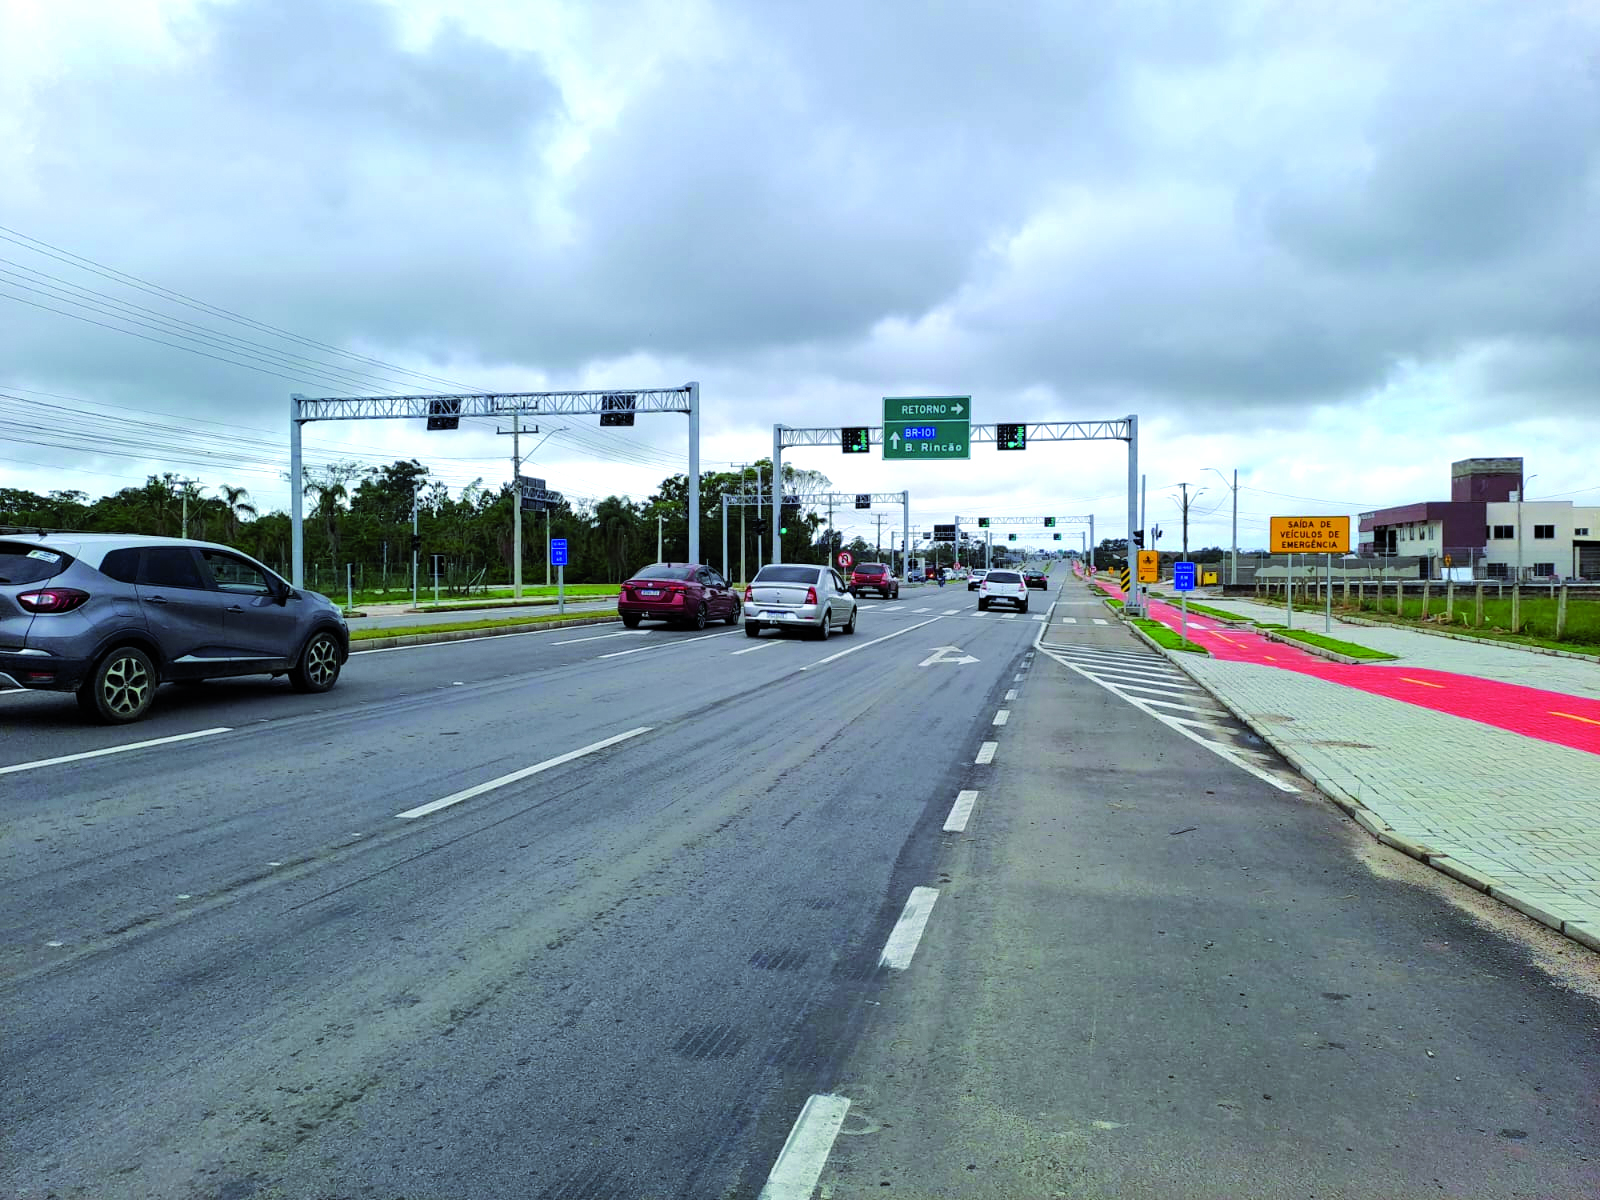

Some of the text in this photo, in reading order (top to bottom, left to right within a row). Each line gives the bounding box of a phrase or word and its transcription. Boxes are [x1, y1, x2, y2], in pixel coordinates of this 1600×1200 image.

[902, 404, 946, 414] RETORNO
[905, 428, 935, 438] BR-101
[905, 442, 962, 452] B. Rincão
[1288, 519, 1314, 528] SAÍDA
[1280, 530, 1322, 538] VEÍCULOS
[1282, 539, 1337, 548] EMERGÊNCIA
